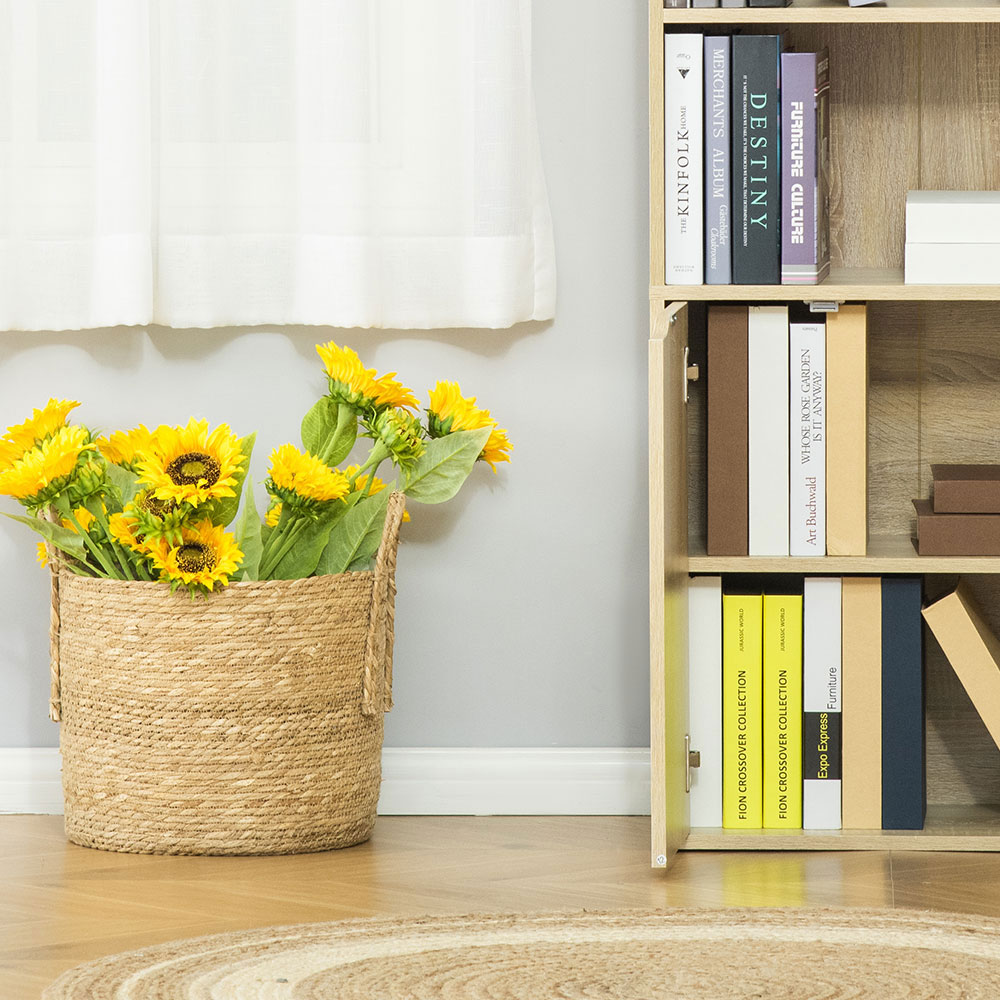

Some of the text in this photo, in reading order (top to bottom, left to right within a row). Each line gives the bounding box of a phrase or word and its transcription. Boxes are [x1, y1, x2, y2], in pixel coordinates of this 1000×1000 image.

[713, 50, 725, 198] MERCHANTS ALBUM
[751, 93, 767, 229] DESTINY
[677, 130, 689, 216] KINFOLK
[791, 184, 804, 244] CULTURE
[801, 349, 810, 464] WHOSE ROSE GARDEN
[813, 371, 822, 442] IS IT ANYWAY?
[805, 476, 816, 545] Art Buchwald
[827, 667, 837, 710] Furniture
[738, 670, 747, 819] FION CROSSOVER COLLECTION
[779, 670, 788, 819] FION CROSSOVER COLLECTION
[818, 713, 830, 779] Expo Express
